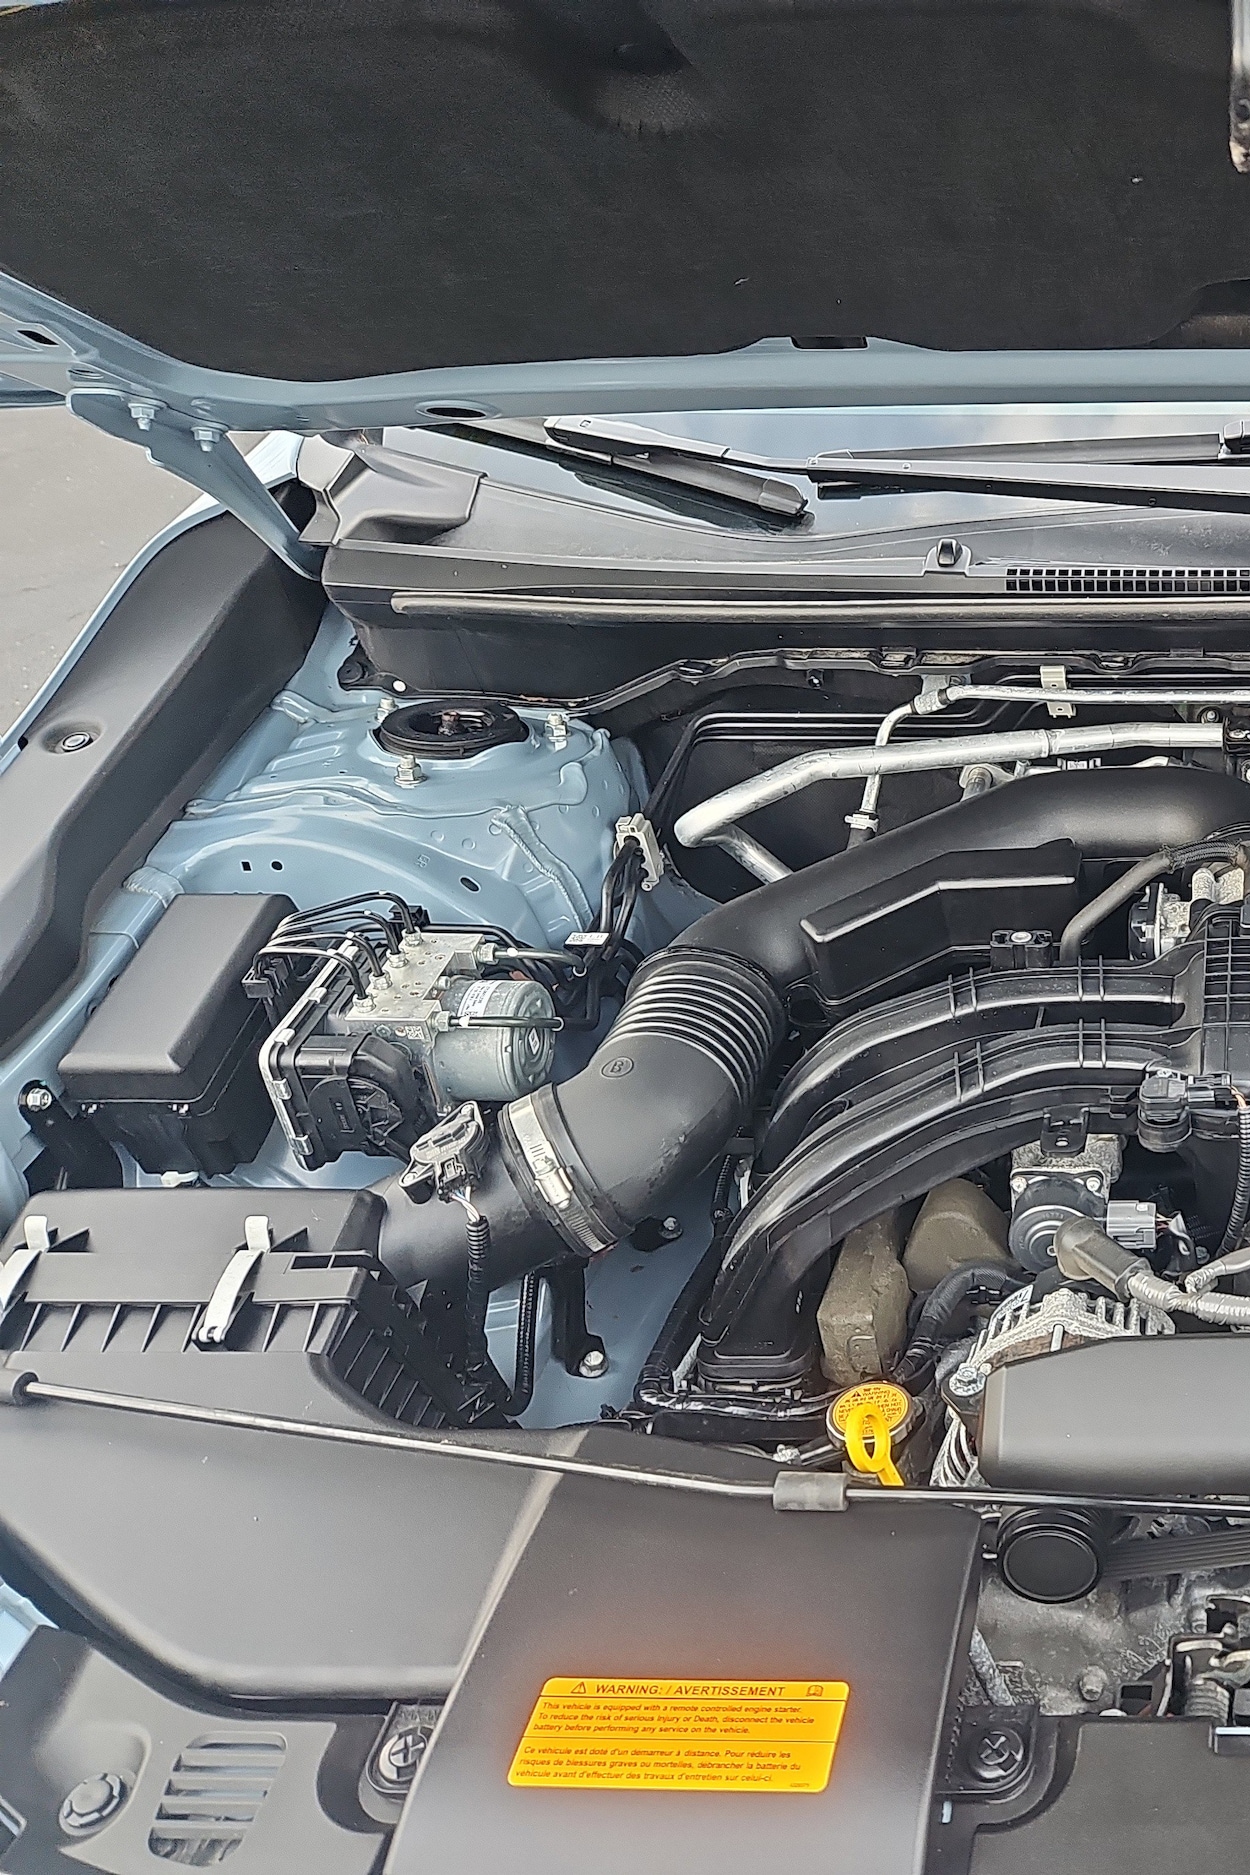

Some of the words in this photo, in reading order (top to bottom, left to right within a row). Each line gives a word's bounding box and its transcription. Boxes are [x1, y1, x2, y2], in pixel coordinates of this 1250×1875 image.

[595, 1684, 663, 1695] WARNING:
[674, 1685, 786, 1696] AVERTISSEMENT
[543, 1702, 559, 1710] This
[603, 1704, 641, 1712] equipped
[744, 1706, 772, 1714] engine
[550, 1713, 578, 1721] reduce
[722, 1716, 768, 1724] disconnect
[533, 1723, 562, 1732] battery
[593, 1725, 638, 1733] performing
[720, 1726, 750, 1734] vehicle.
[524, 1746, 535, 1754] Ce
[725, 1750, 745, 1758] Pour
[519, 1758, 551, 1766] risques
[566, 1759, 607, 1767] blessures
[609, 1761, 638, 1769] graves
